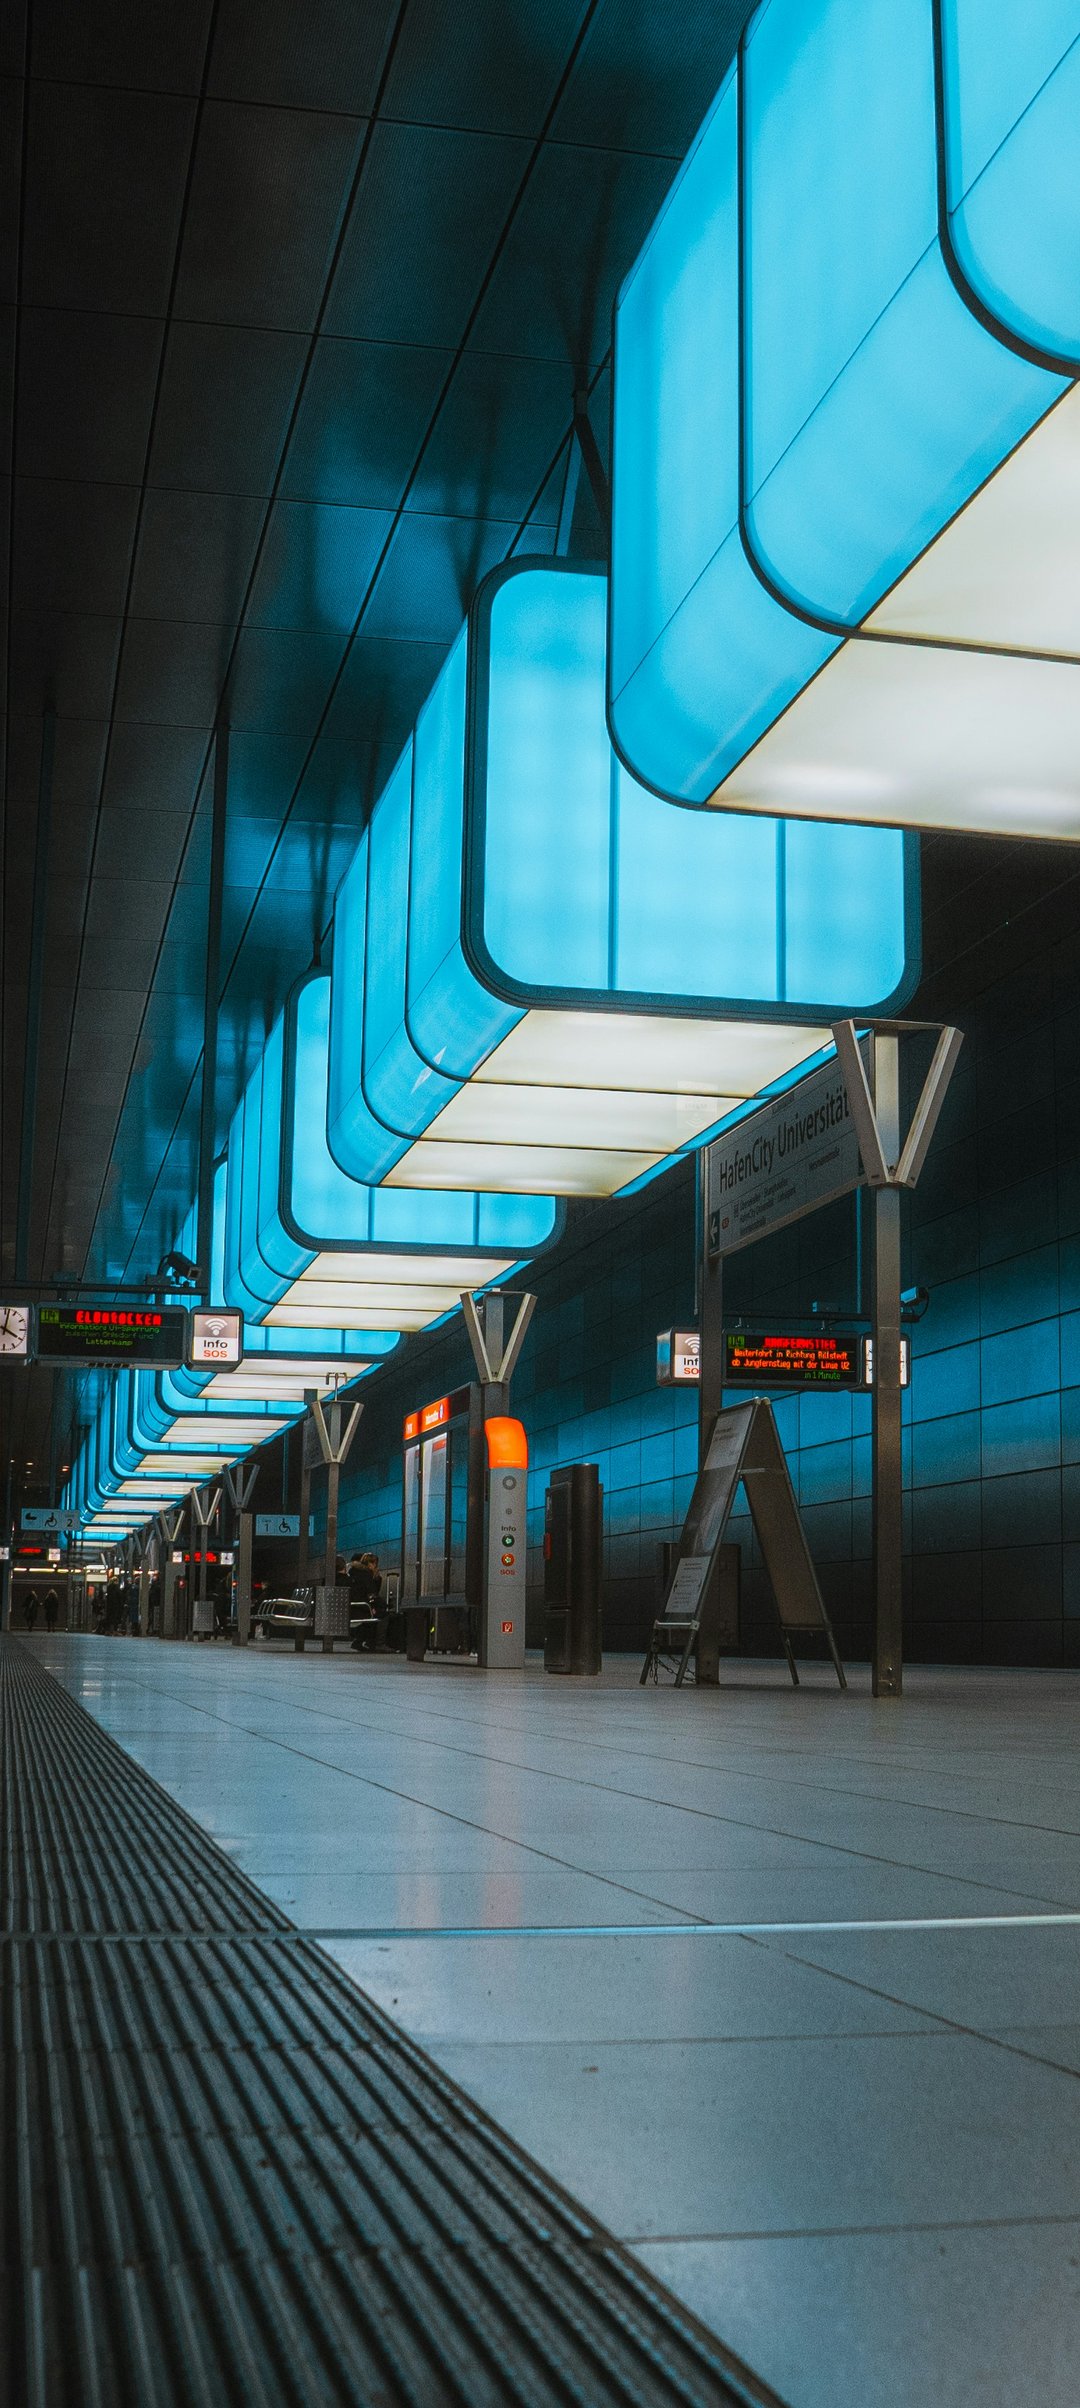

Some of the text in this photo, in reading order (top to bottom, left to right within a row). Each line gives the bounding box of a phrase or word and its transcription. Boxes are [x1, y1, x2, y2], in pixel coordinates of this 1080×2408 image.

[720, 1136, 775, 1193] HafenCity
[778, 1085, 849, 1157] Universität
[203, 1340, 228, 1348] Info
[203, 1350, 228, 1358] SOS
[734, 1348, 773, 1357] Weiterfahrt
[776, 1350, 783, 1358] in
[786, 1350, 815, 1360] Richtung
[744, 1359, 790, 1369] Jungfernstieg
[794, 1360, 803, 1368] mit
[806, 1360, 818, 1368] der
[821, 1361, 838, 1369] Linie
[684, 1367, 701, 1375] SO
[818, 1371, 841, 1379] Minute
[67, 1518, 73, 1527] 2
[264, 1523, 270, 1532] 1
